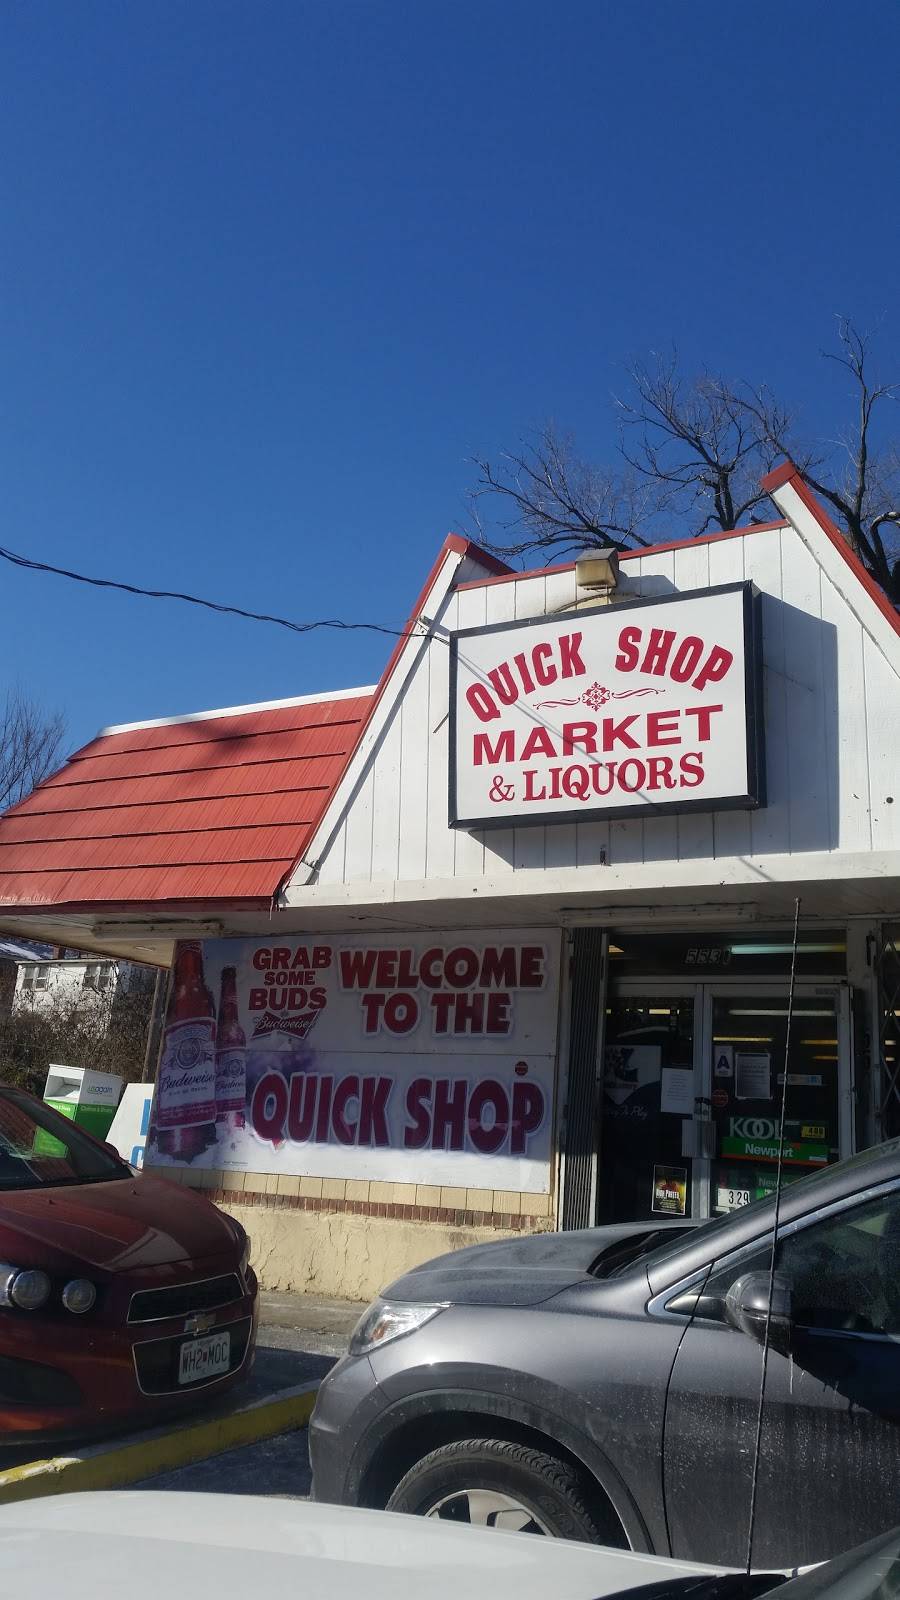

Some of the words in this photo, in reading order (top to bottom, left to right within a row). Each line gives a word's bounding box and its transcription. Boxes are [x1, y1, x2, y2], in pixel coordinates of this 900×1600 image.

[465, 632, 587, 723] QUICK
[615, 626, 734, 691] SHOP
[473, 704, 724, 766] MARKET
[489, 775, 515, 802] &
[523, 752, 705, 802] LIQUORS
[252, 946, 333, 970] GRAB
[340, 947, 545, 988] WELCOME
[264, 971, 316, 986] SOME
[248, 987, 328, 1011] BUDS
[362, 993, 419, 1033] TO
[431, 993, 512, 1034] THE
[717, 1055, 730, 1069] A
[252, 1072, 394, 1150] QUICK
[404, 1077, 545, 1155] SHOP
[730, 1116, 786, 1141] KOOL
[745, 1143, 794, 1158] Newport
